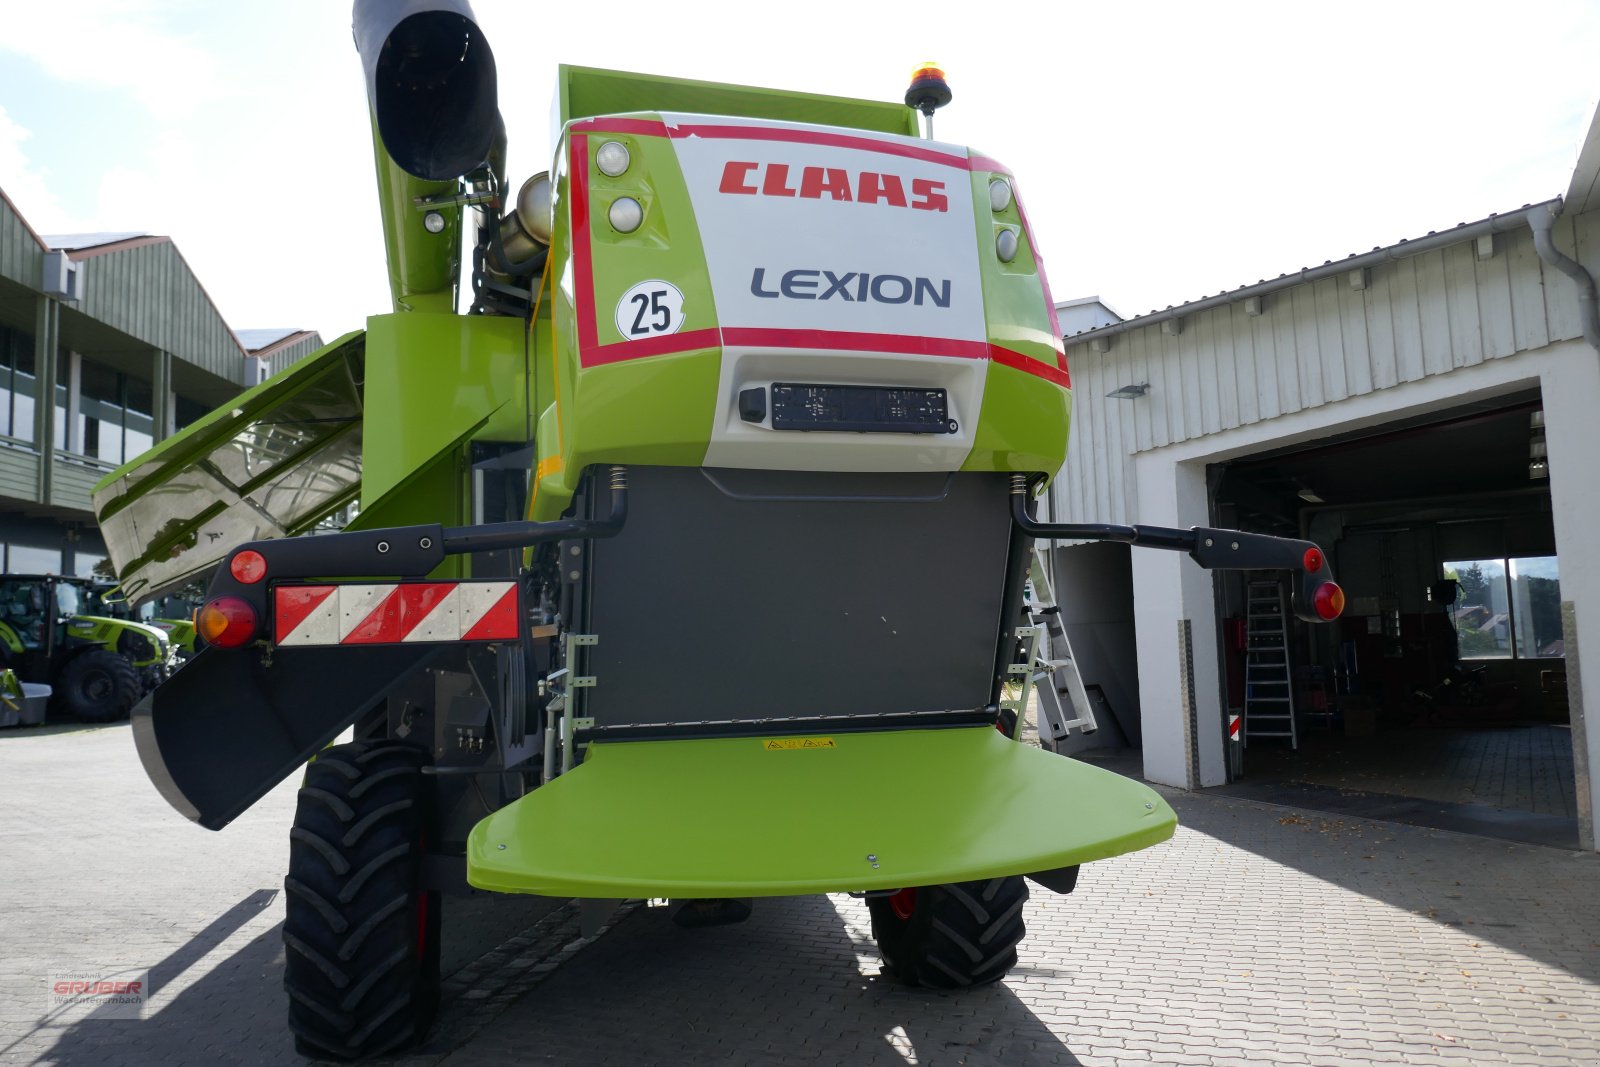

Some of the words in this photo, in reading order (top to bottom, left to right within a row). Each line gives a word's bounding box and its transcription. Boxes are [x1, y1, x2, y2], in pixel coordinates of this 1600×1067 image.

[719, 161, 948, 212] CLAAS
[751, 268, 951, 308] LEXION
[631, 290, 670, 335] 25
